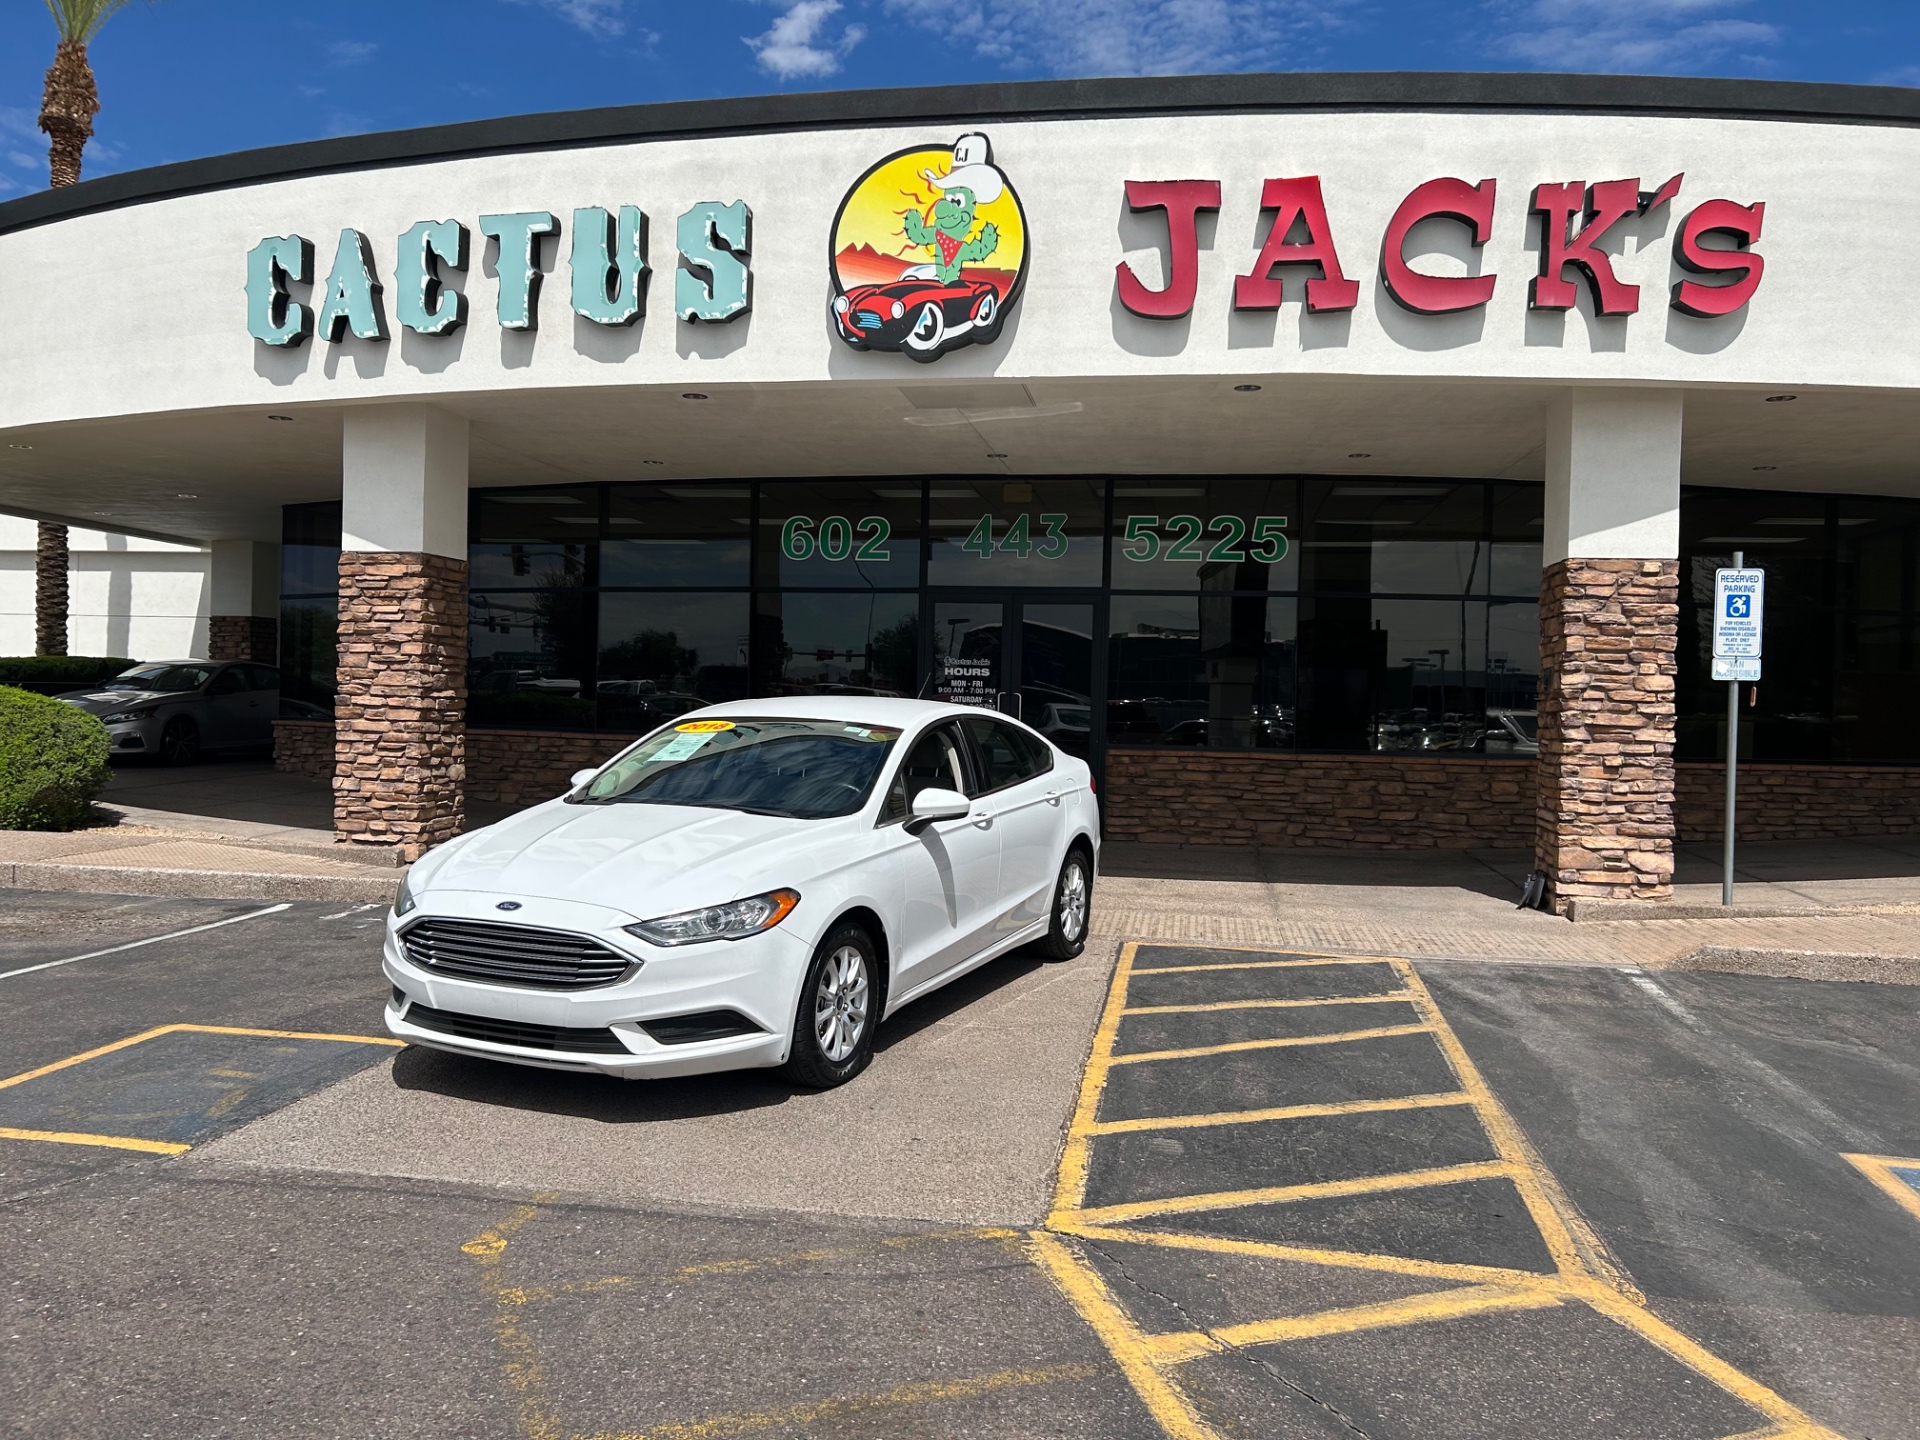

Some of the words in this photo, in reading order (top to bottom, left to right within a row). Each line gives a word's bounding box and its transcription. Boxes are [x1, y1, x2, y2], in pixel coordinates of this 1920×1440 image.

[955, 147, 969, 162] CJ
[244, 199, 753, 347] CACTUS
[1115, 172, 1766, 320] JACK'S
[781, 515, 891, 562] 602
[962, 513, 1069, 559] 443
[1122, 515, 1290, 562] 5225
[1720, 574, 1760, 583] RESERVED
[1723, 584, 1756, 593] PARKING
[1729, 660, 1745, 668] VAN
[944, 667, 990, 676] HOURS
[950, 695, 983, 703] SATURDAY
